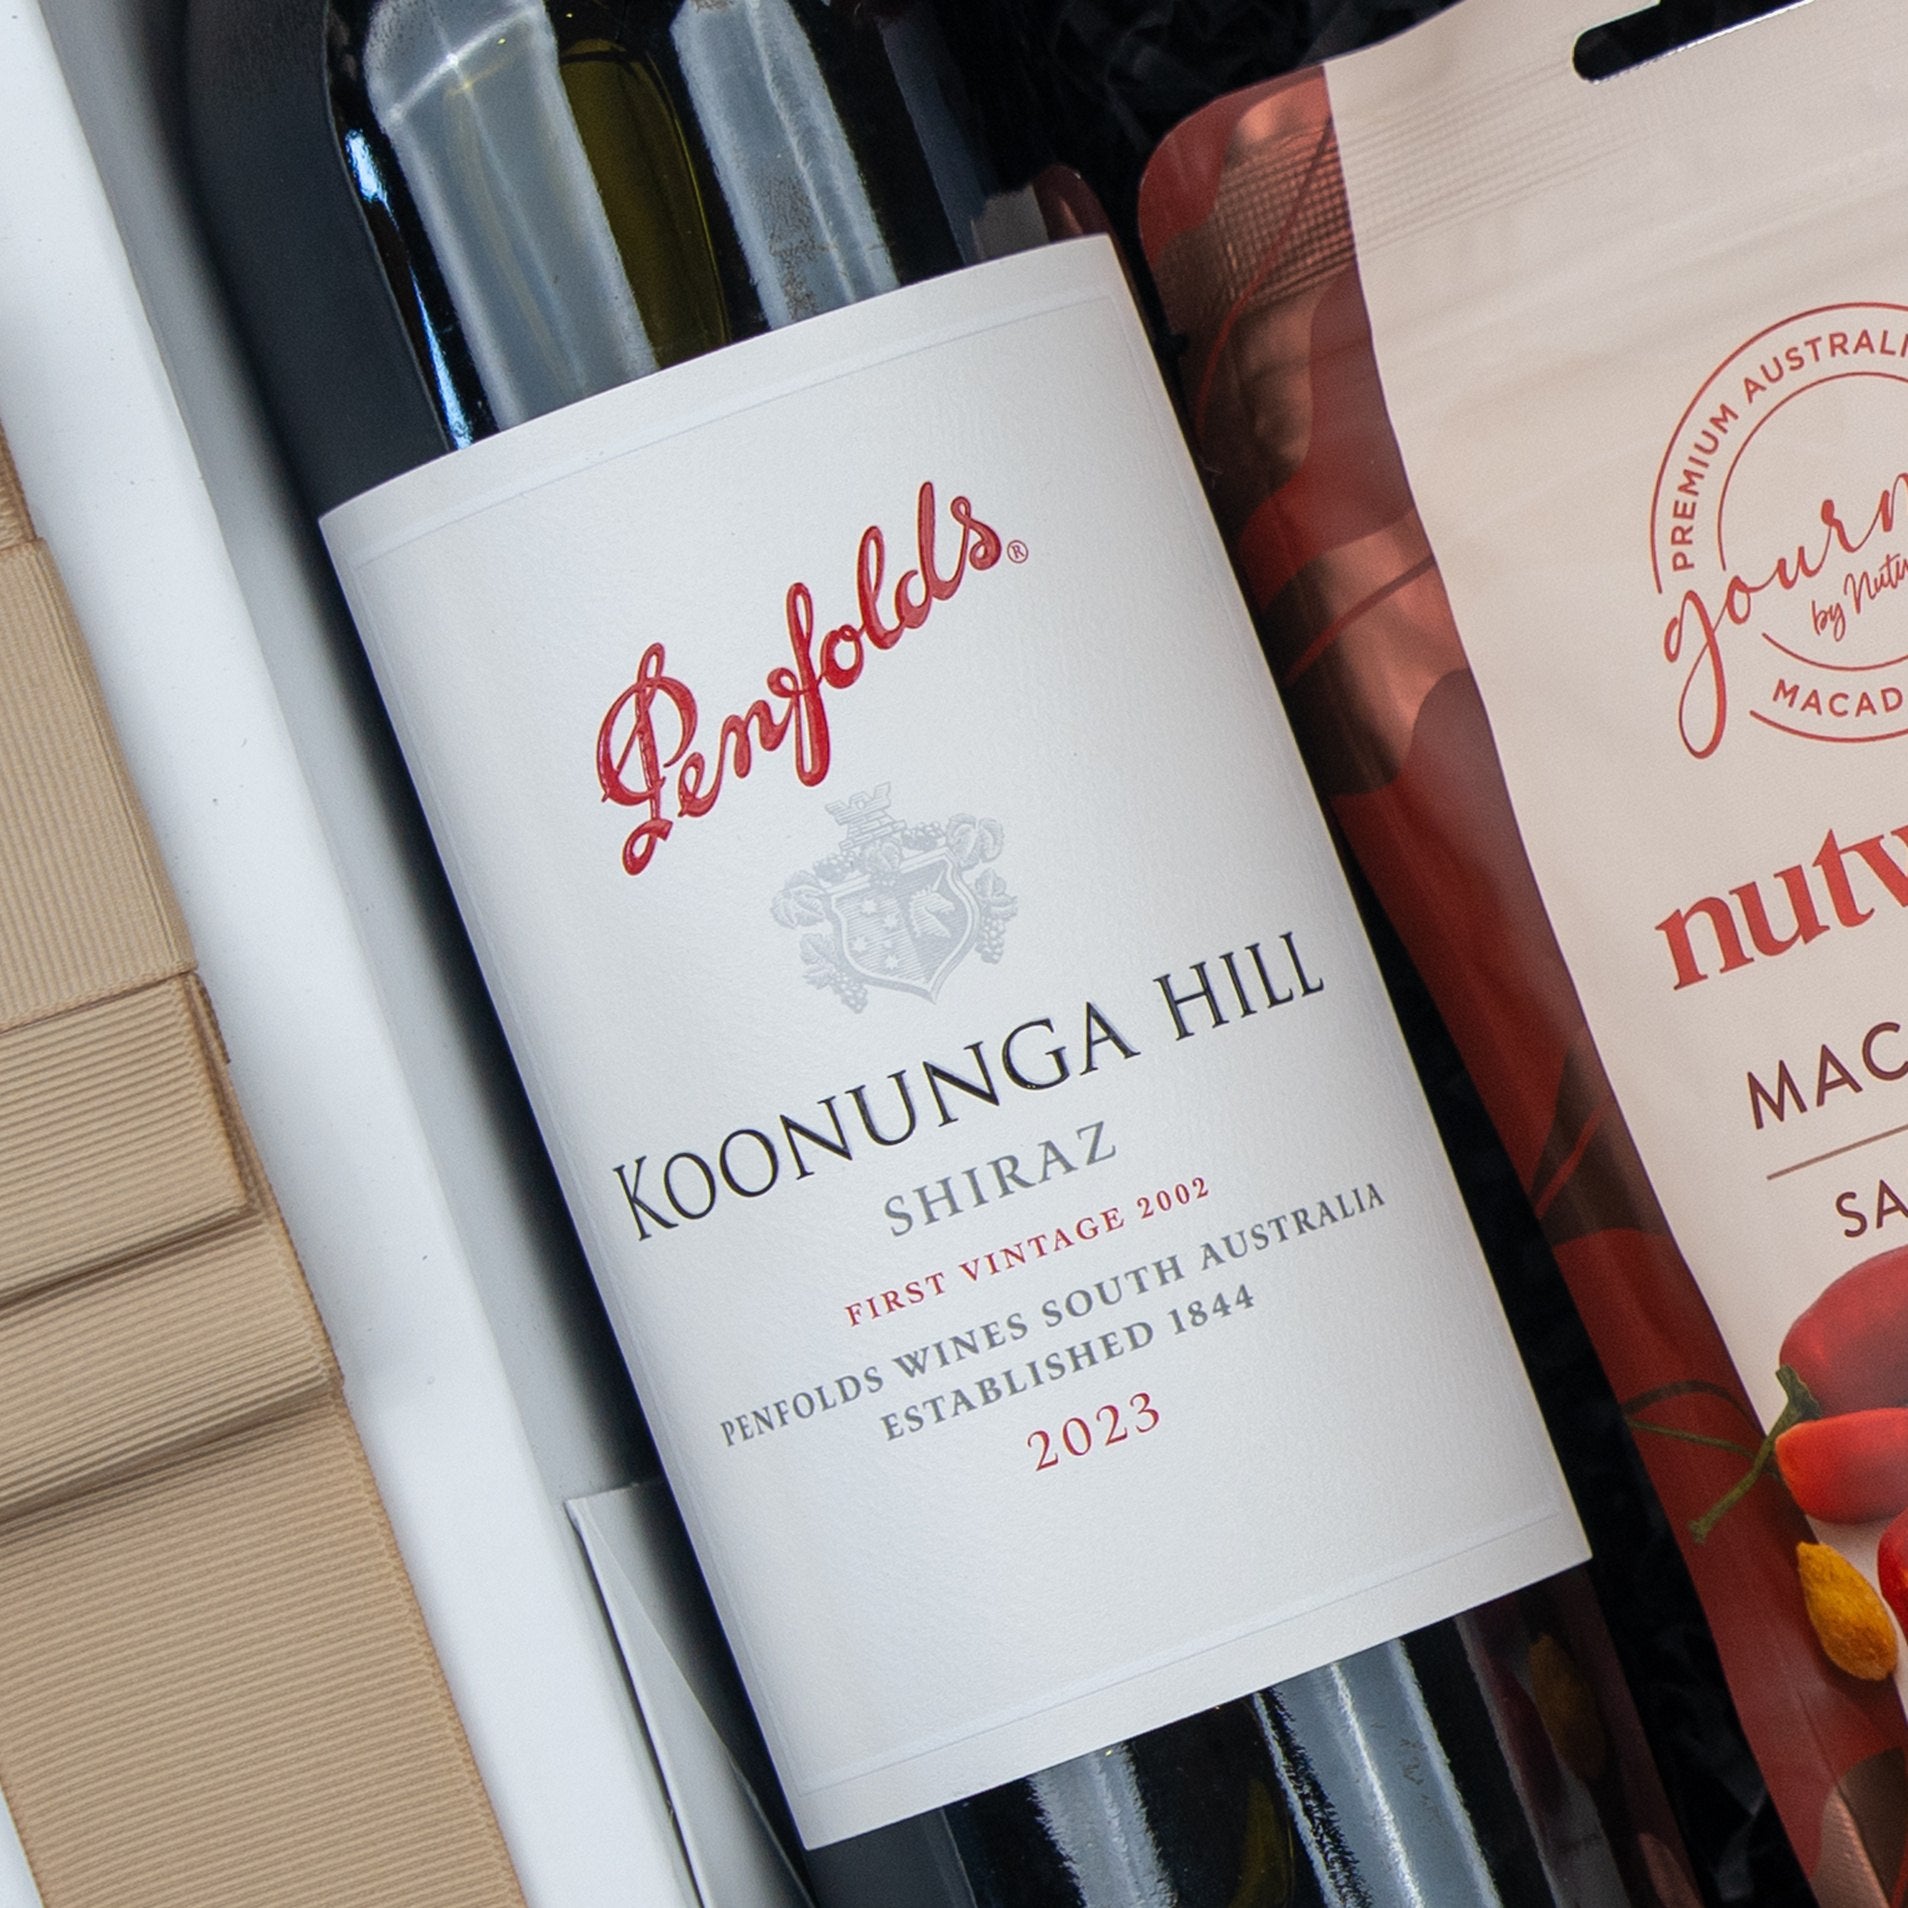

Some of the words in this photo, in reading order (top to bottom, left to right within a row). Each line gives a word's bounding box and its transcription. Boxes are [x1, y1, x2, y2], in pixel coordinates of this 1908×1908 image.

[1671, 403, 1739, 572] PREMIUM
[1811, 599, 1847, 643] by
[1772, 678, 1904, 718] MACAD
[613, 1001, 1141, 1242] KOONUNGA
[1151, 930, 1325, 1041] HILL
[1746, 1021, 1908, 1130] MAC
[884, 1120, 1117, 1238] SHIRAZ
[719, 1365, 884, 1448] PENFOLDS
[891, 1312, 1028, 1381] WINES
[1041, 1254, 1185, 1328] SOUTH
[1200, 1182, 1385, 1271] AUSTRALIA
[844, 1271, 946, 1328] FIRST
[958, 1207, 1125, 1282] VINTAGE
[1136, 1176, 1210, 1220] 2002
[879, 1321, 1154, 1442] ESTABLISHED
[1167, 1283, 1255, 1336] 1844
[1026, 1391, 1160, 1472] 2023
